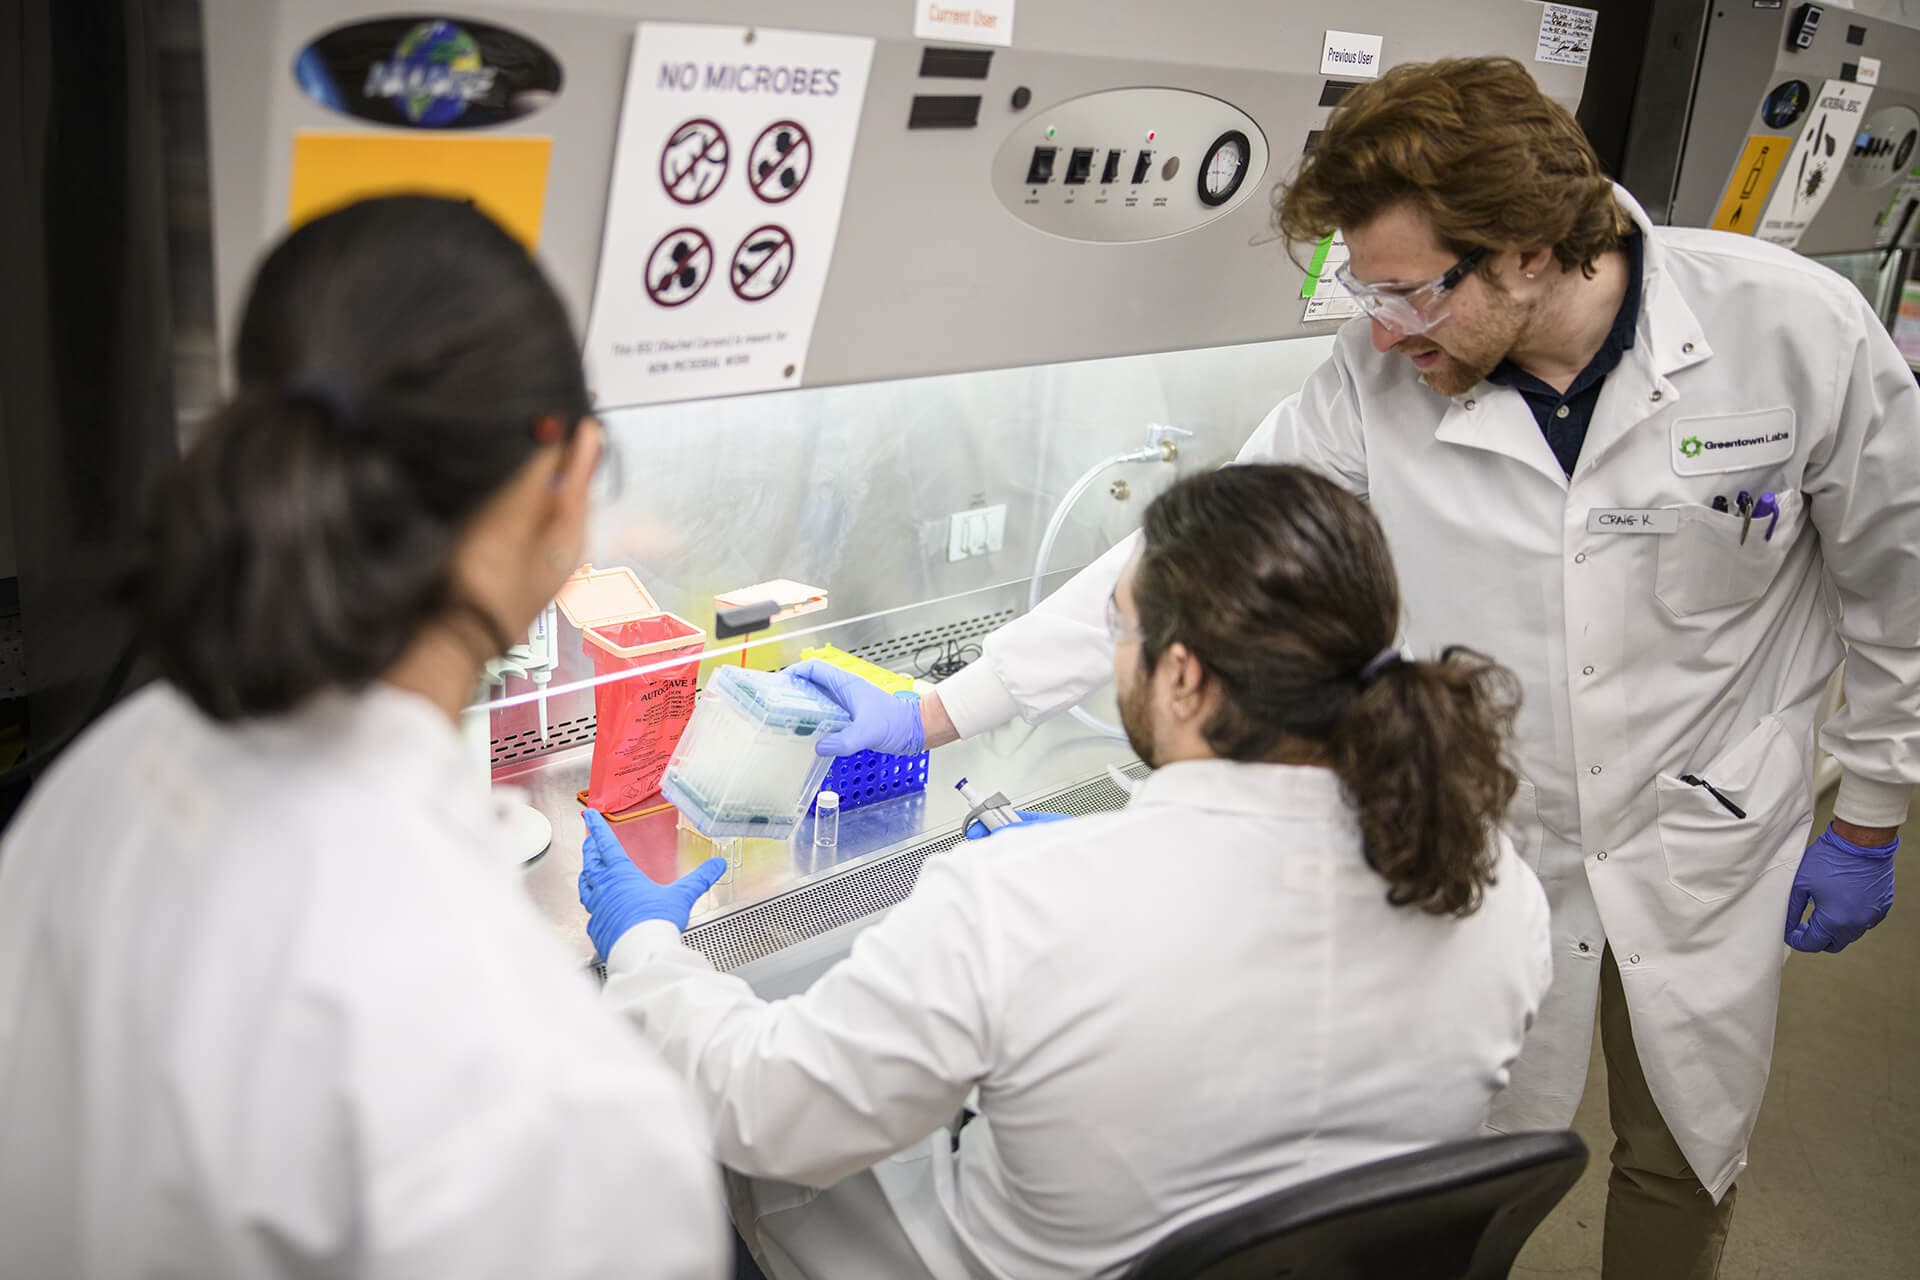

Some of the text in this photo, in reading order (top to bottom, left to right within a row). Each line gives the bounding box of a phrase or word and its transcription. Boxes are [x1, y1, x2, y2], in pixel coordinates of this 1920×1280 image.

[928, 3, 999, 29] Current User
[1327, 47, 1374, 65] Previous User
[656, 61, 841, 97] NO MICROBES
[1704, 432, 1789, 450] Greentown Labs
[641, 679, 688, 701] AUTOCAVE
